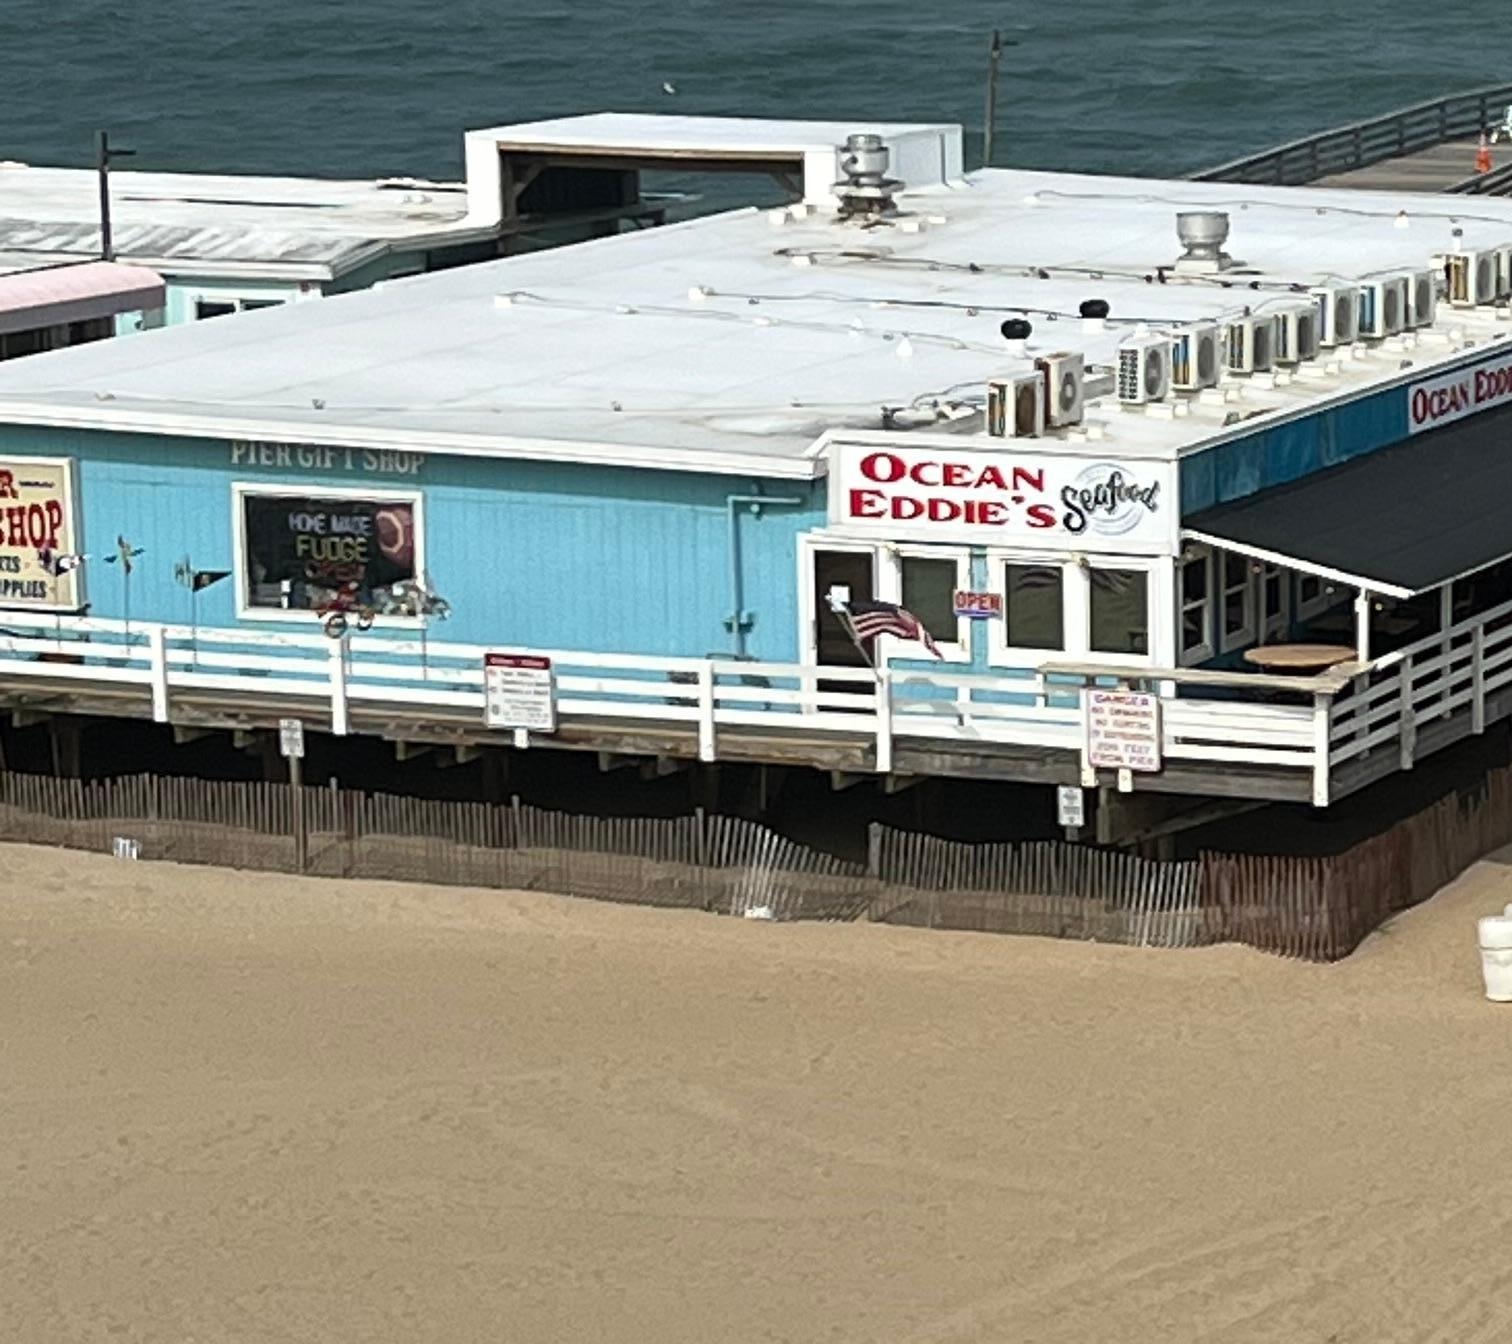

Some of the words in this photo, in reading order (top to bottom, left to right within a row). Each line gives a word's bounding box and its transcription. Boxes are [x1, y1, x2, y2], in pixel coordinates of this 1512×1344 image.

[1412, 383, 1469, 425] OCEAN
[230, 440, 292, 467] PIER
[297, 444, 354, 470] GIFT
[363, 448, 425, 474] SHOP
[860, 452, 1045, 492] OCEAN
[849, 488, 1058, 529] EDDIE'S
[1061, 471, 1161, 535] Seafood
[288, 512, 327, 534] HOME
[295, 535, 370, 563] FUDGE
[955, 591, 1002, 611] OPEN
